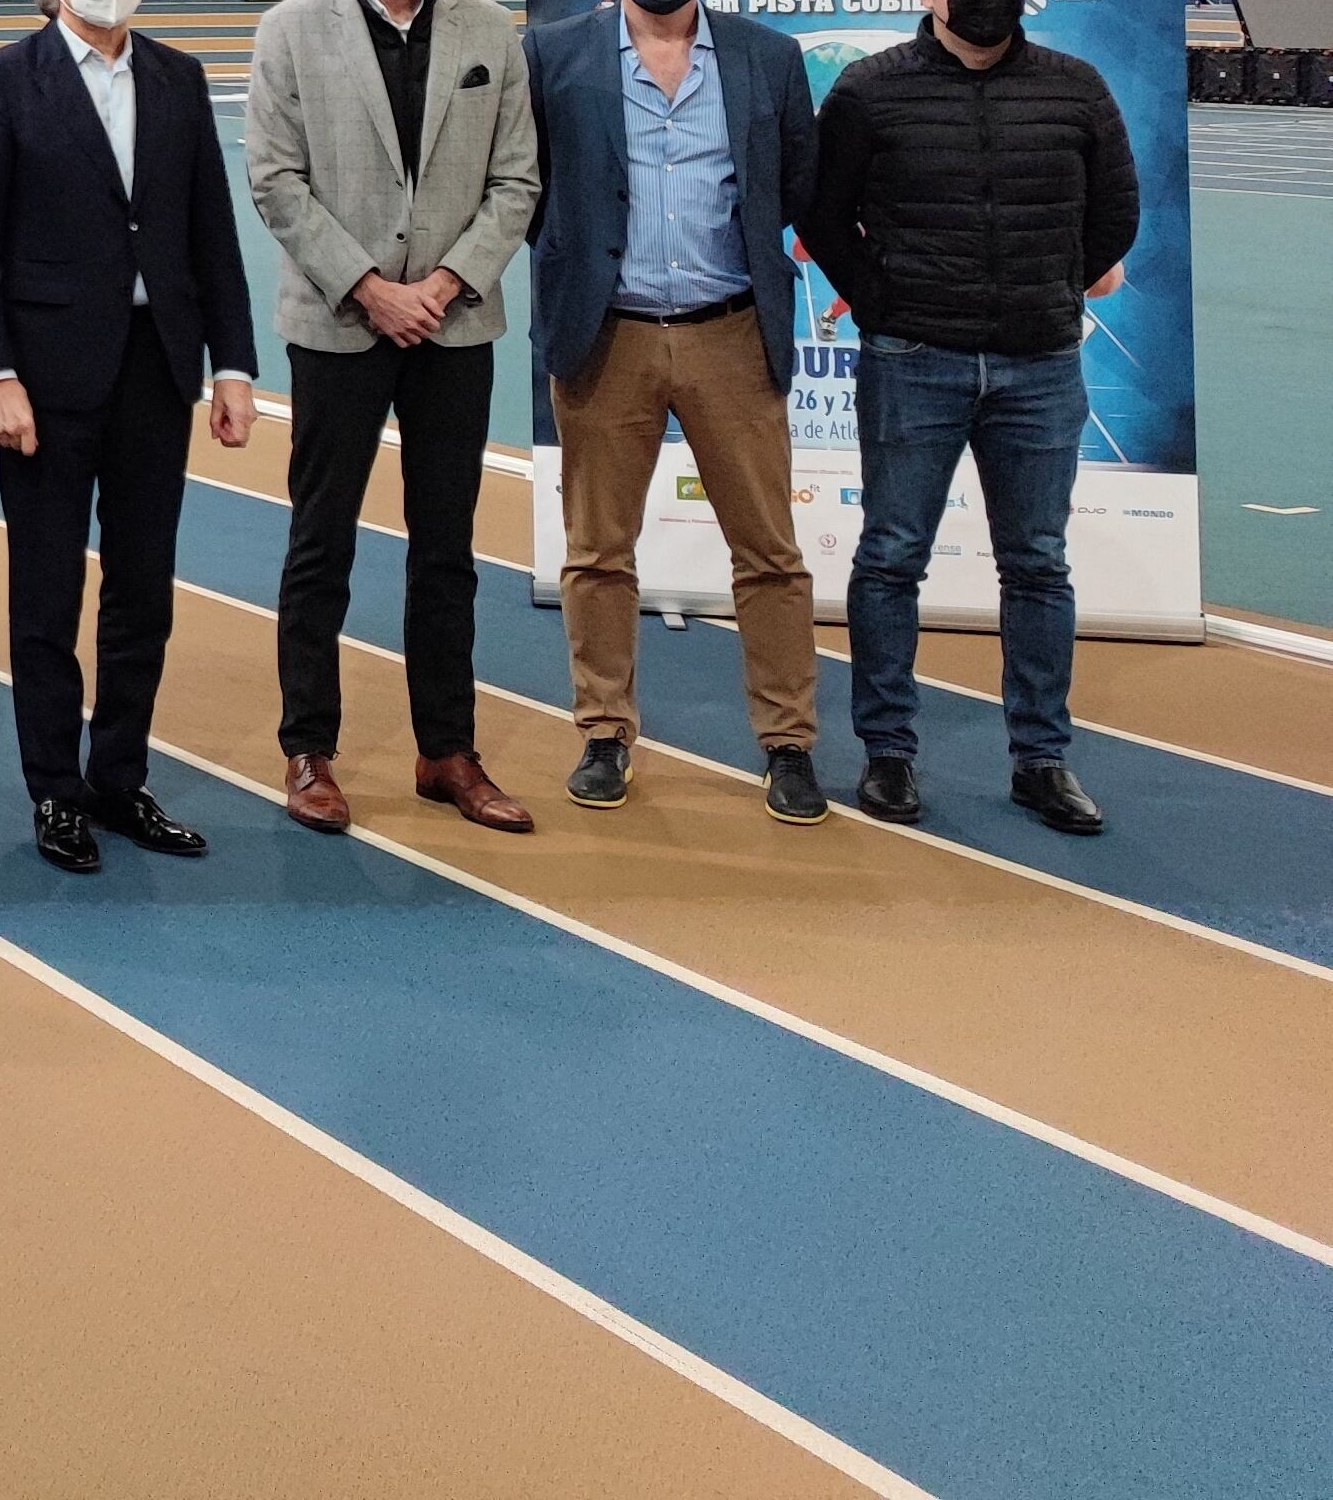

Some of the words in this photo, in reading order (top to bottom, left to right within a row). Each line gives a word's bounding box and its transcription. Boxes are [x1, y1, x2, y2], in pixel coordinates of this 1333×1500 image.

[795, 389, 817, 410] 26
[824, 391, 836, 416] y
[806, 422, 823, 439] de
[810, 483, 821, 493] fit
[1077, 507, 1106, 515] DJO
[1132, 509, 1174, 518] MONDO
